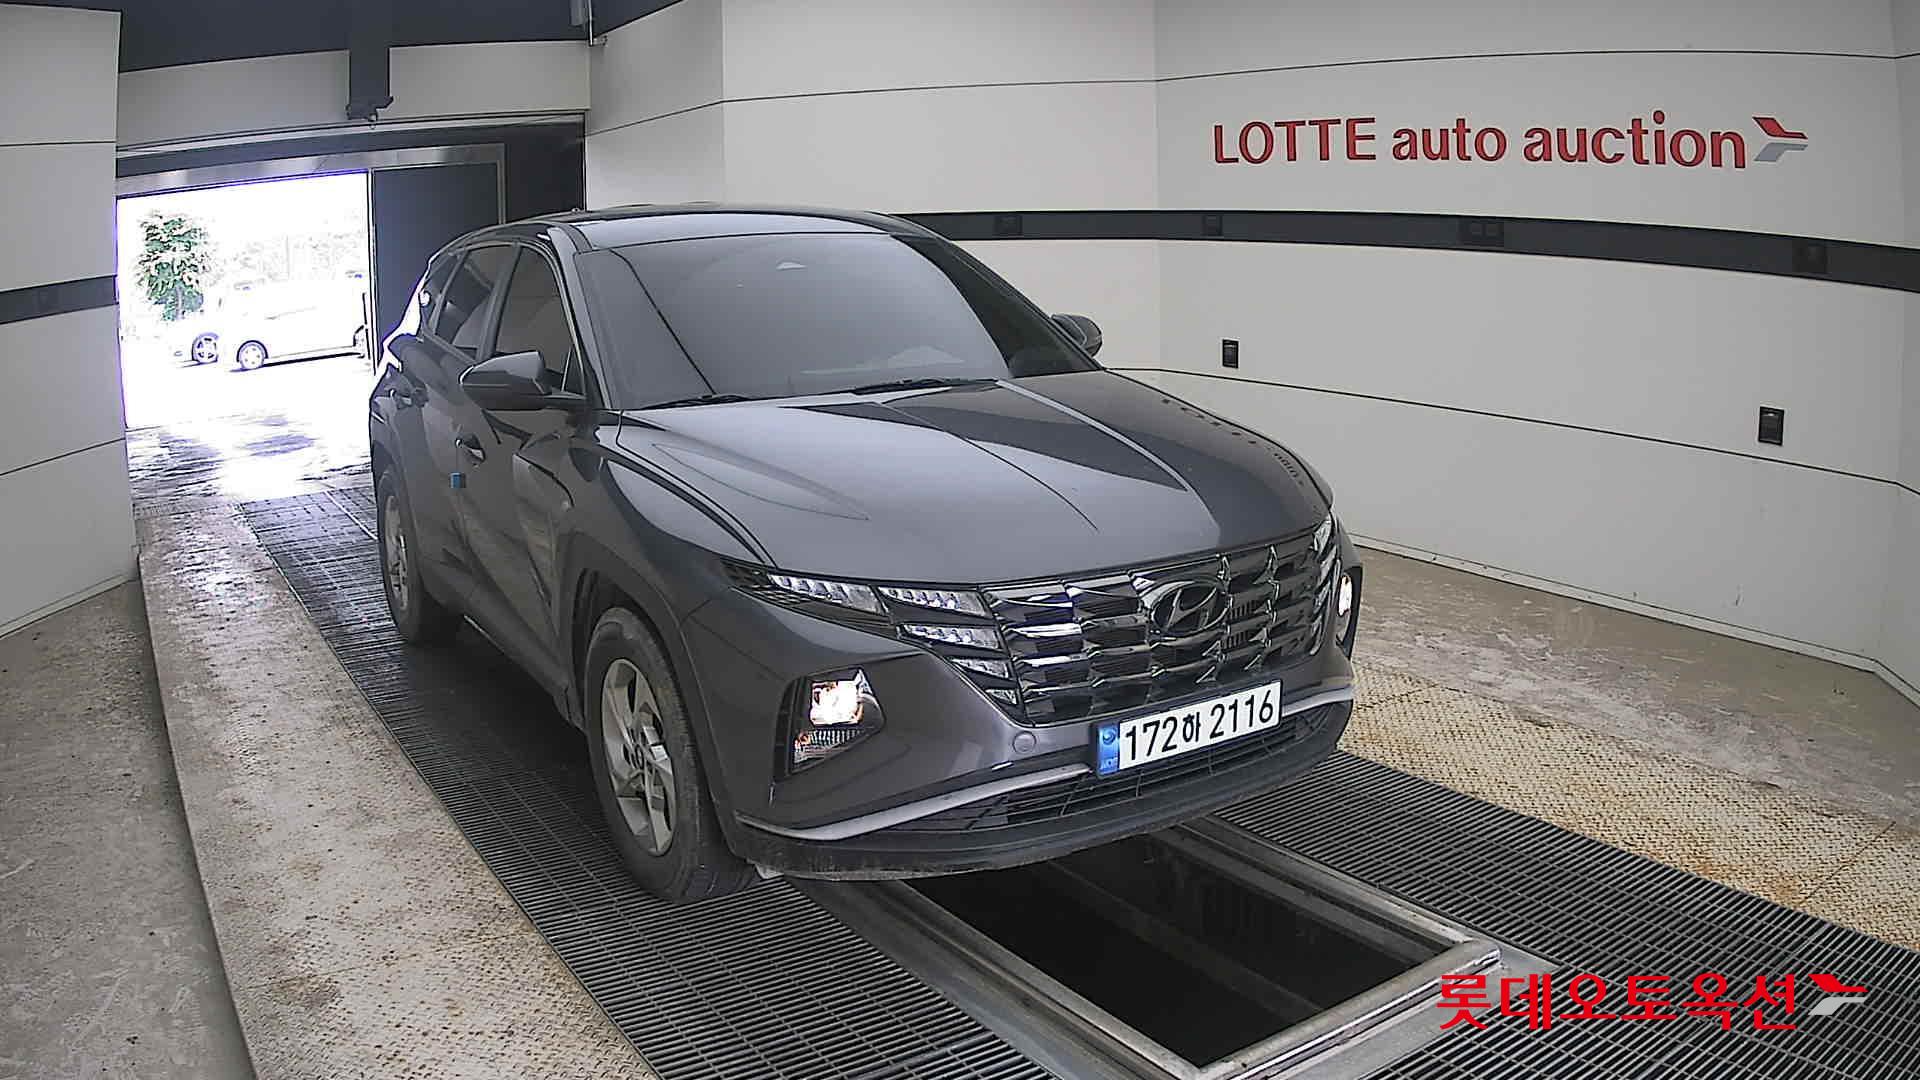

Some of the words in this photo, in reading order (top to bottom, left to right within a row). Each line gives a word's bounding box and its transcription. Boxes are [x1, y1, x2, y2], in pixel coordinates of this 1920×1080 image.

[1214, 117, 1376, 164] LOTTE
[1392, 118, 1507, 161] auto
[1523, 110, 1746, 168] auction
[1125, 711, 1201, 761] 172하
[1209, 690, 1274, 739] 2116
